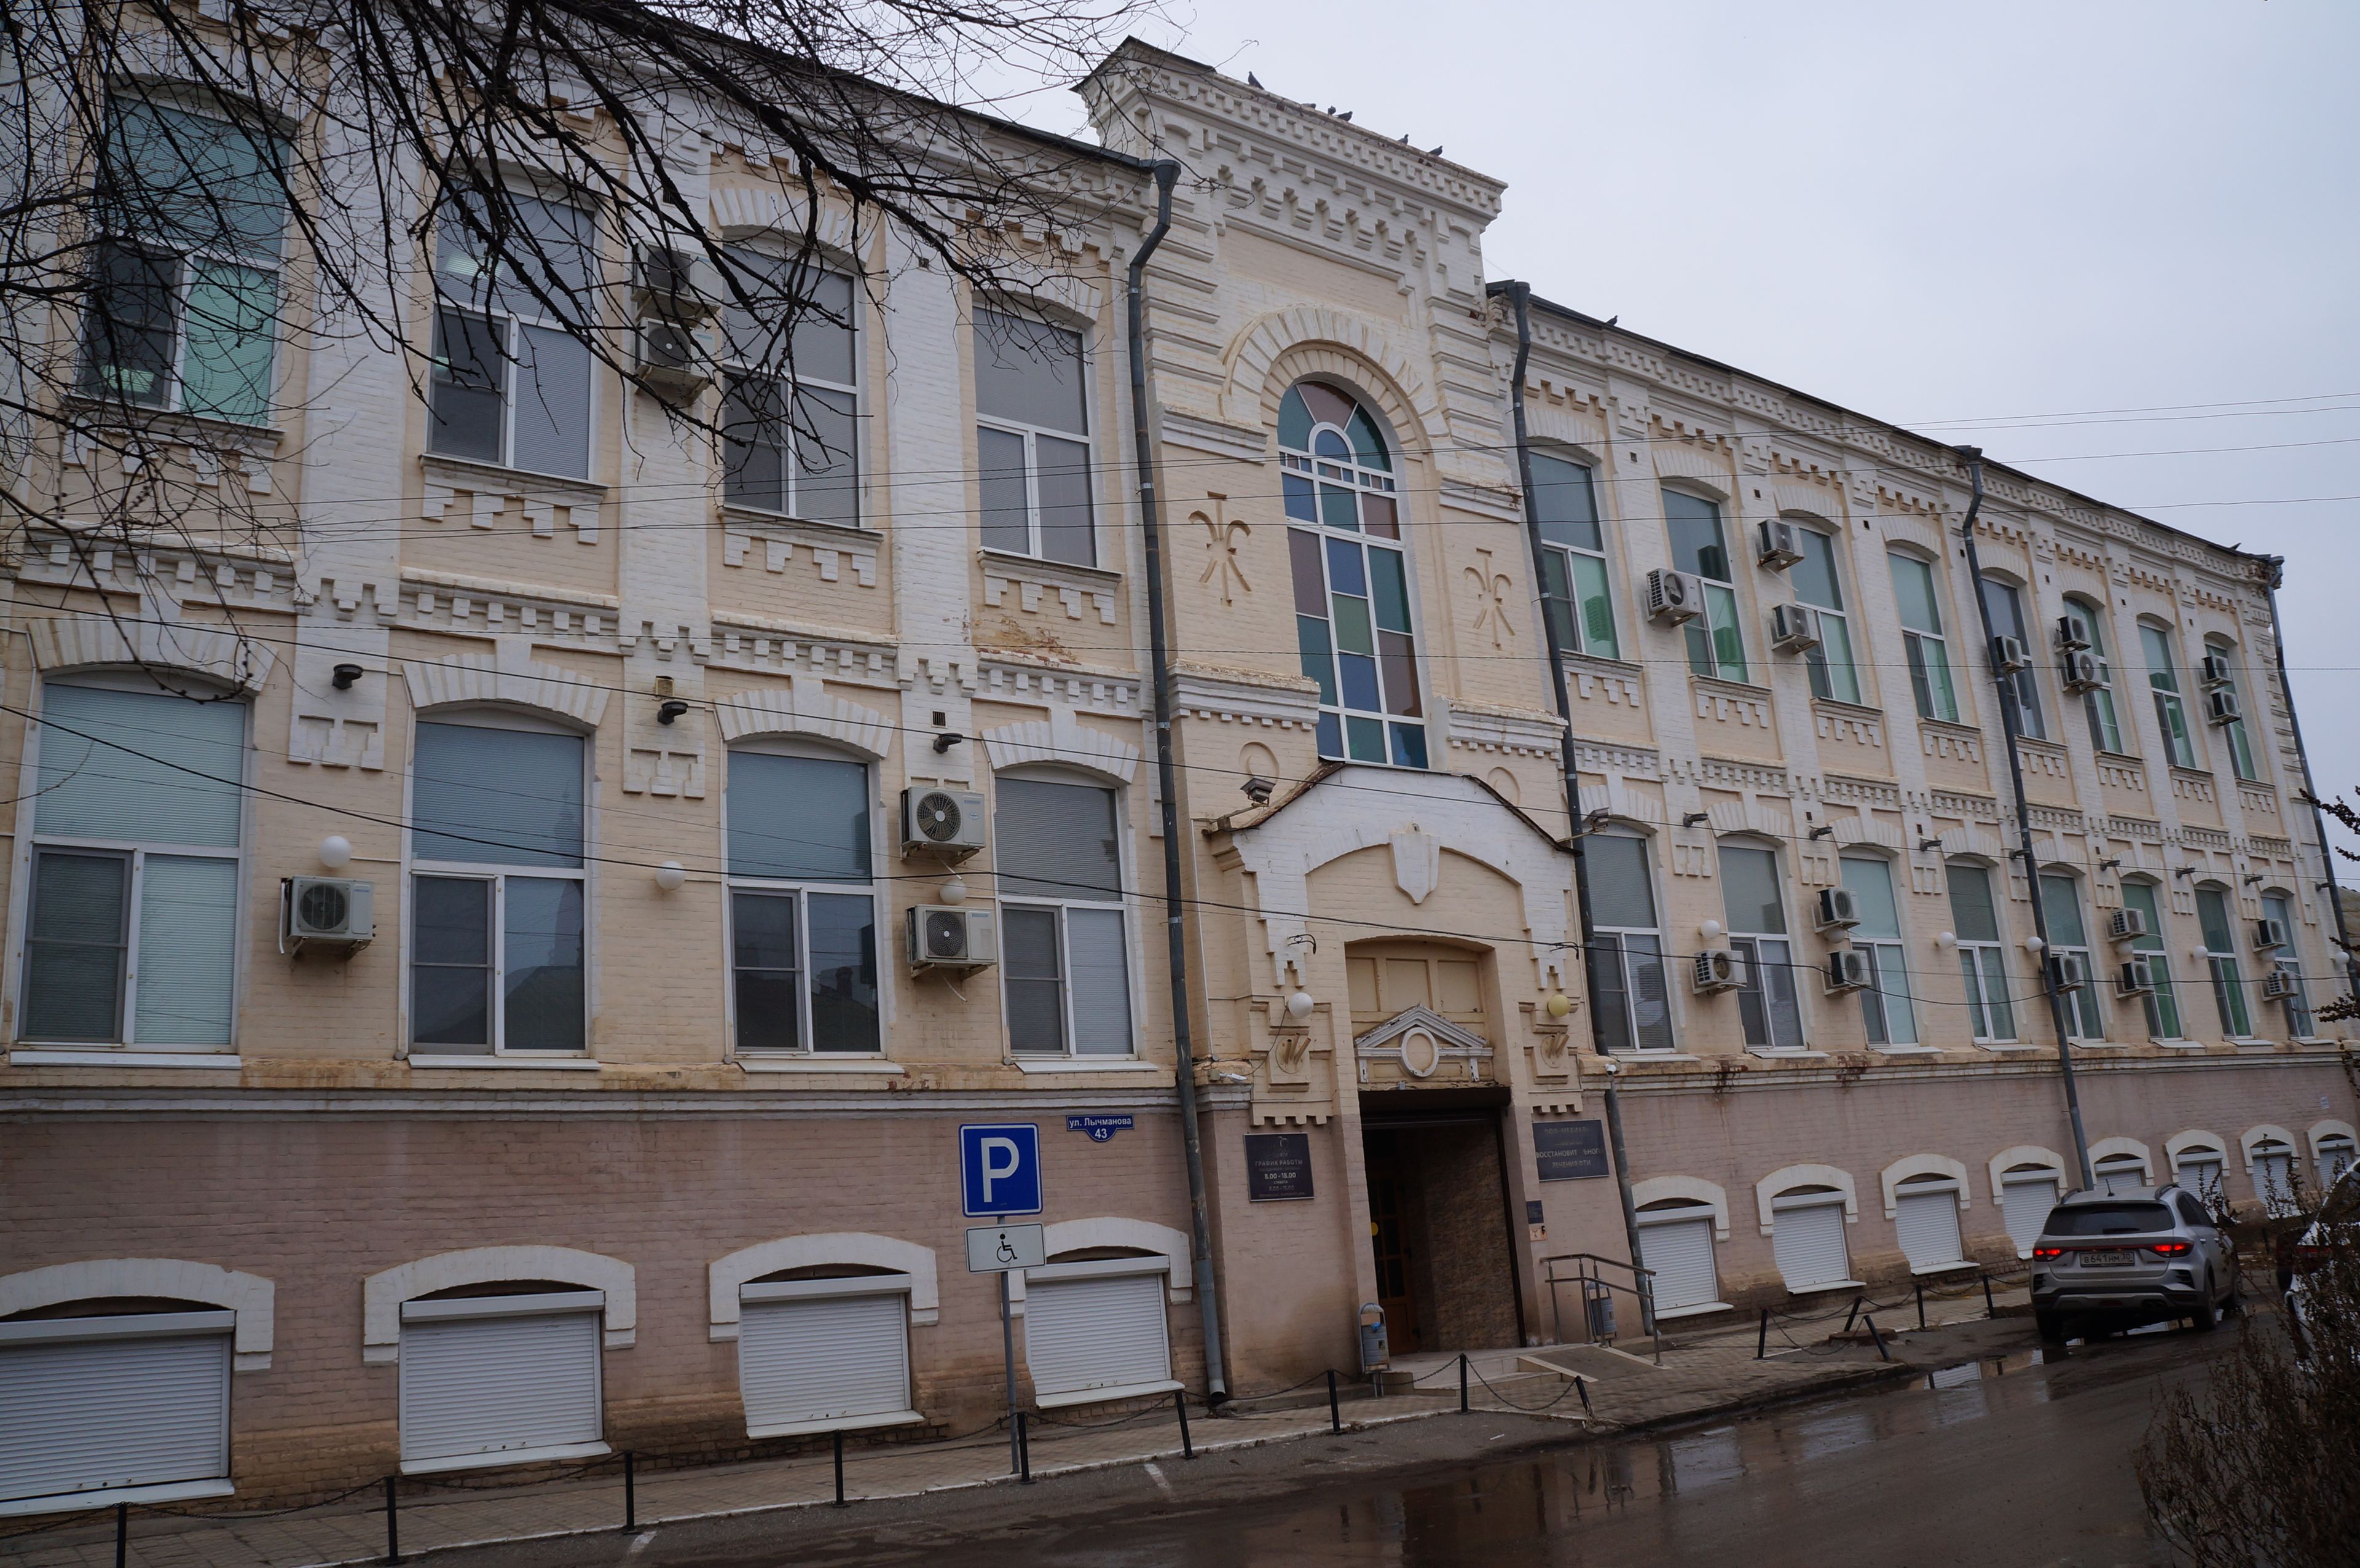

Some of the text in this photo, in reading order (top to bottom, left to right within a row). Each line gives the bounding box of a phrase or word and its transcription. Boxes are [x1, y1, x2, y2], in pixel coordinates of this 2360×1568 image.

[1069, 1118, 1131, 1129] ул. Лычманова
[1095, 1128, 1107, 1139] 43
[981, 1137, 1020, 1202] P
